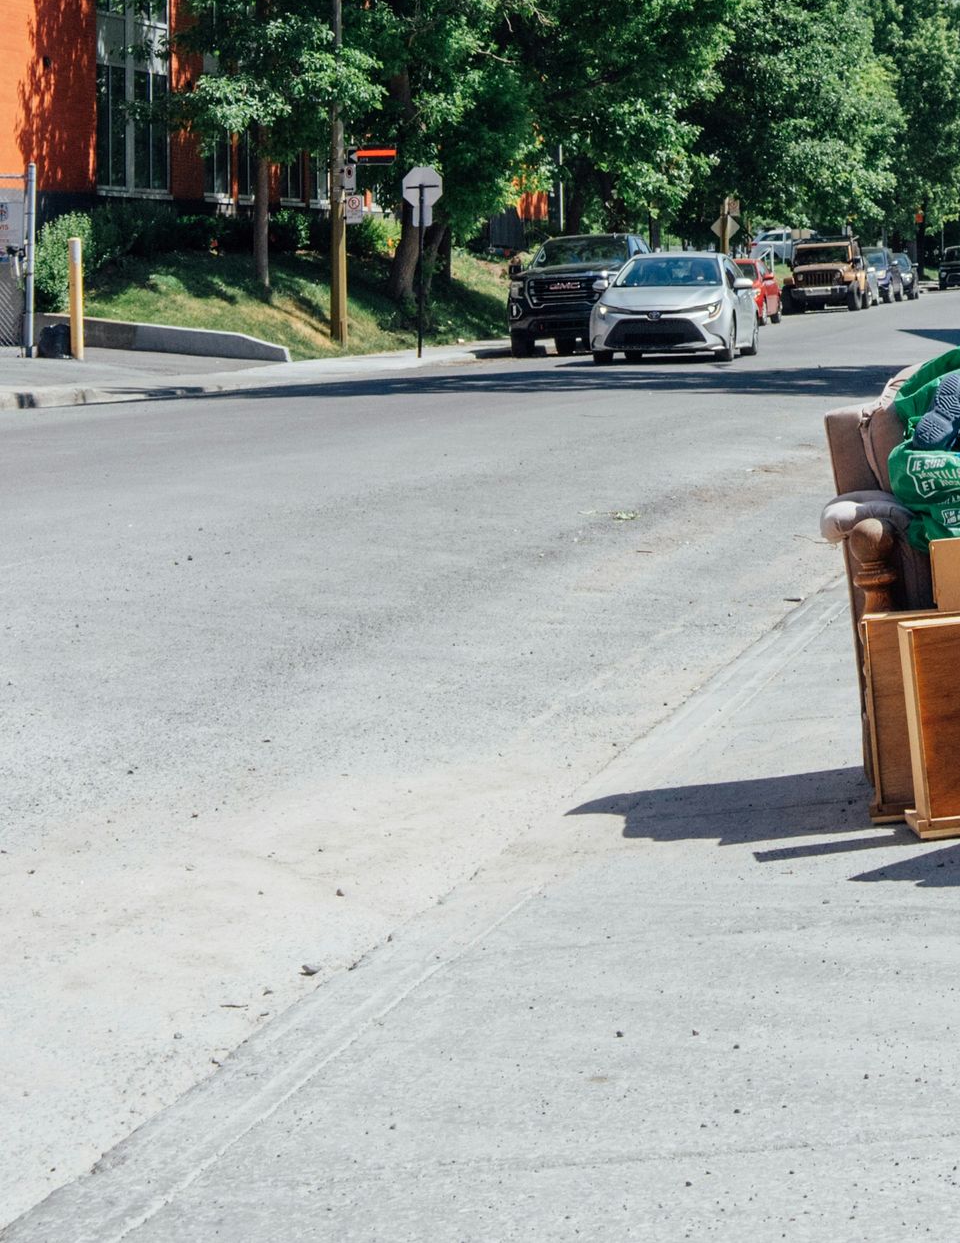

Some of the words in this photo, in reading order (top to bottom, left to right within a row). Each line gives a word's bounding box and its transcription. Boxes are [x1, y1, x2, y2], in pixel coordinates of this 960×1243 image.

[549, 281, 581, 290] GMC
[912, 459, 922, 471] JE
[922, 479, 936, 492] ET
